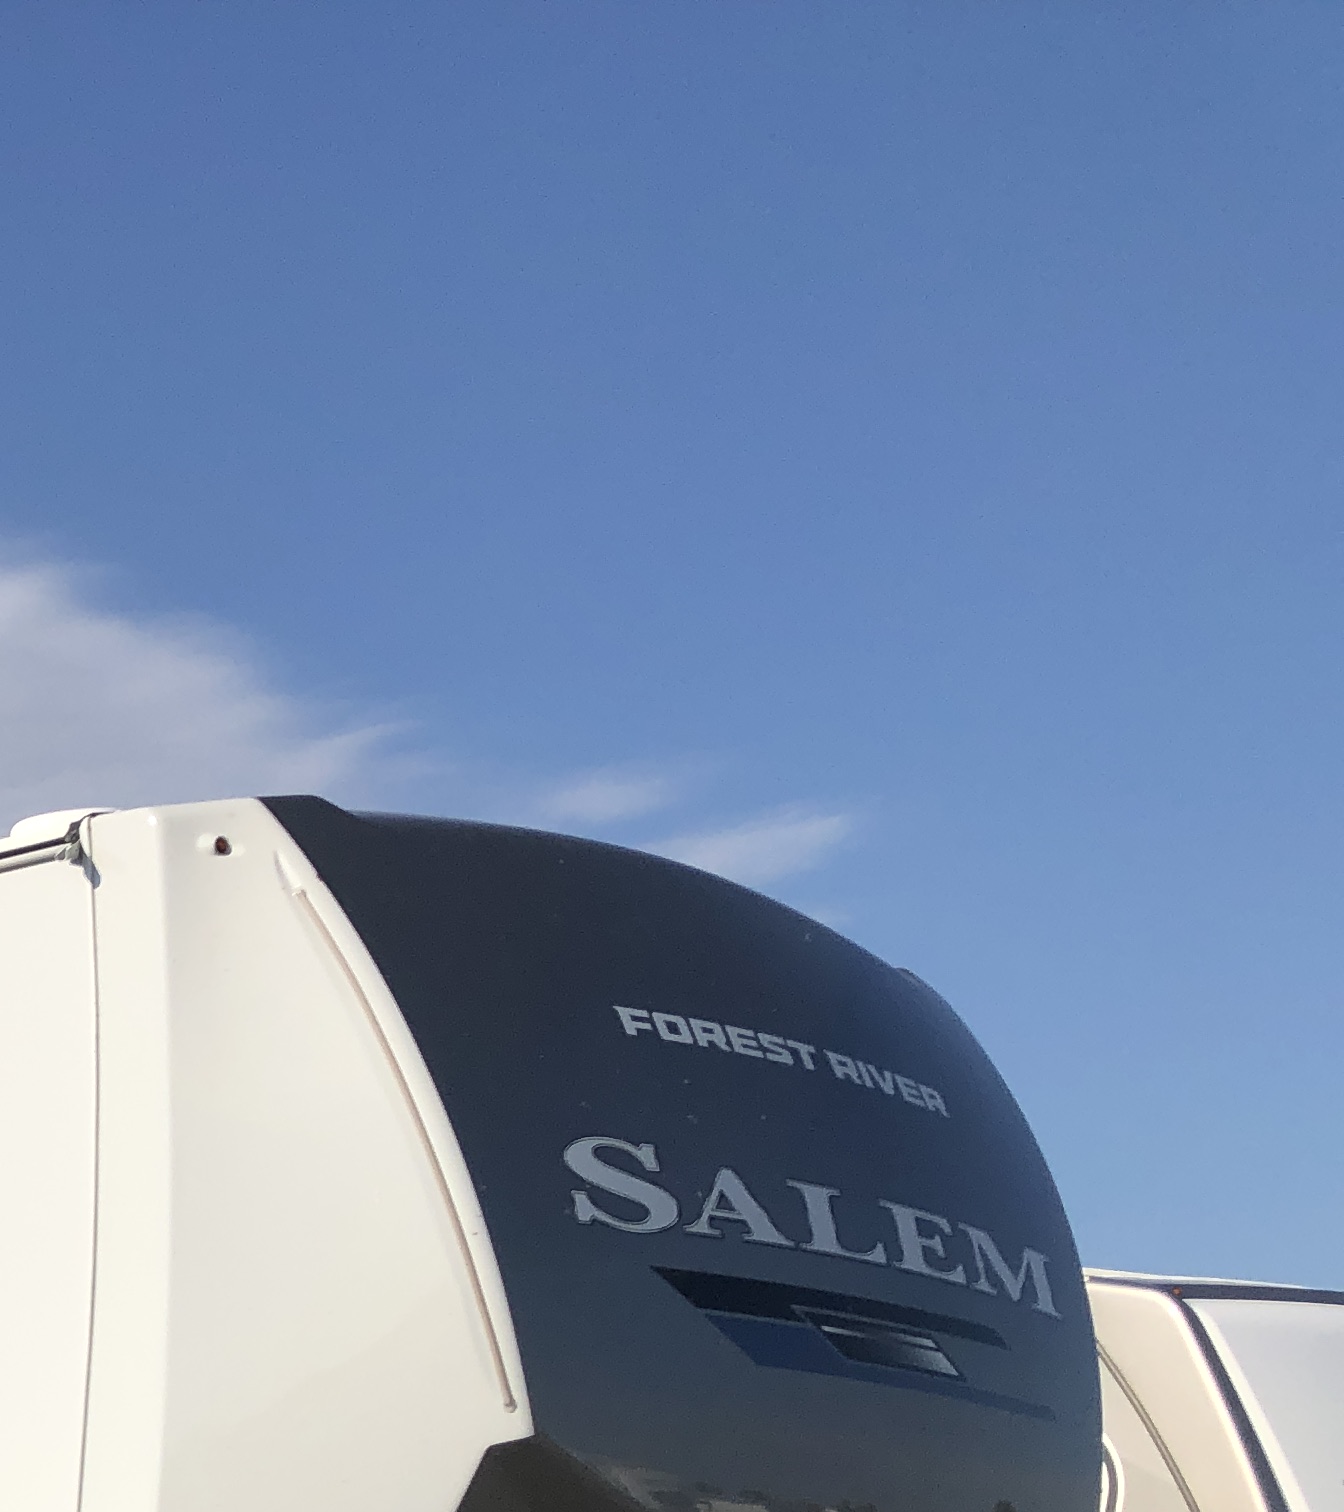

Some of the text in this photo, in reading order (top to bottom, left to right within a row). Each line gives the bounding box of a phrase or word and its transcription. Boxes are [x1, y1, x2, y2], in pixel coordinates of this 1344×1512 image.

[613, 1005, 950, 1118] FOREST RIVER
[563, 1135, 1062, 1319] SALEM
